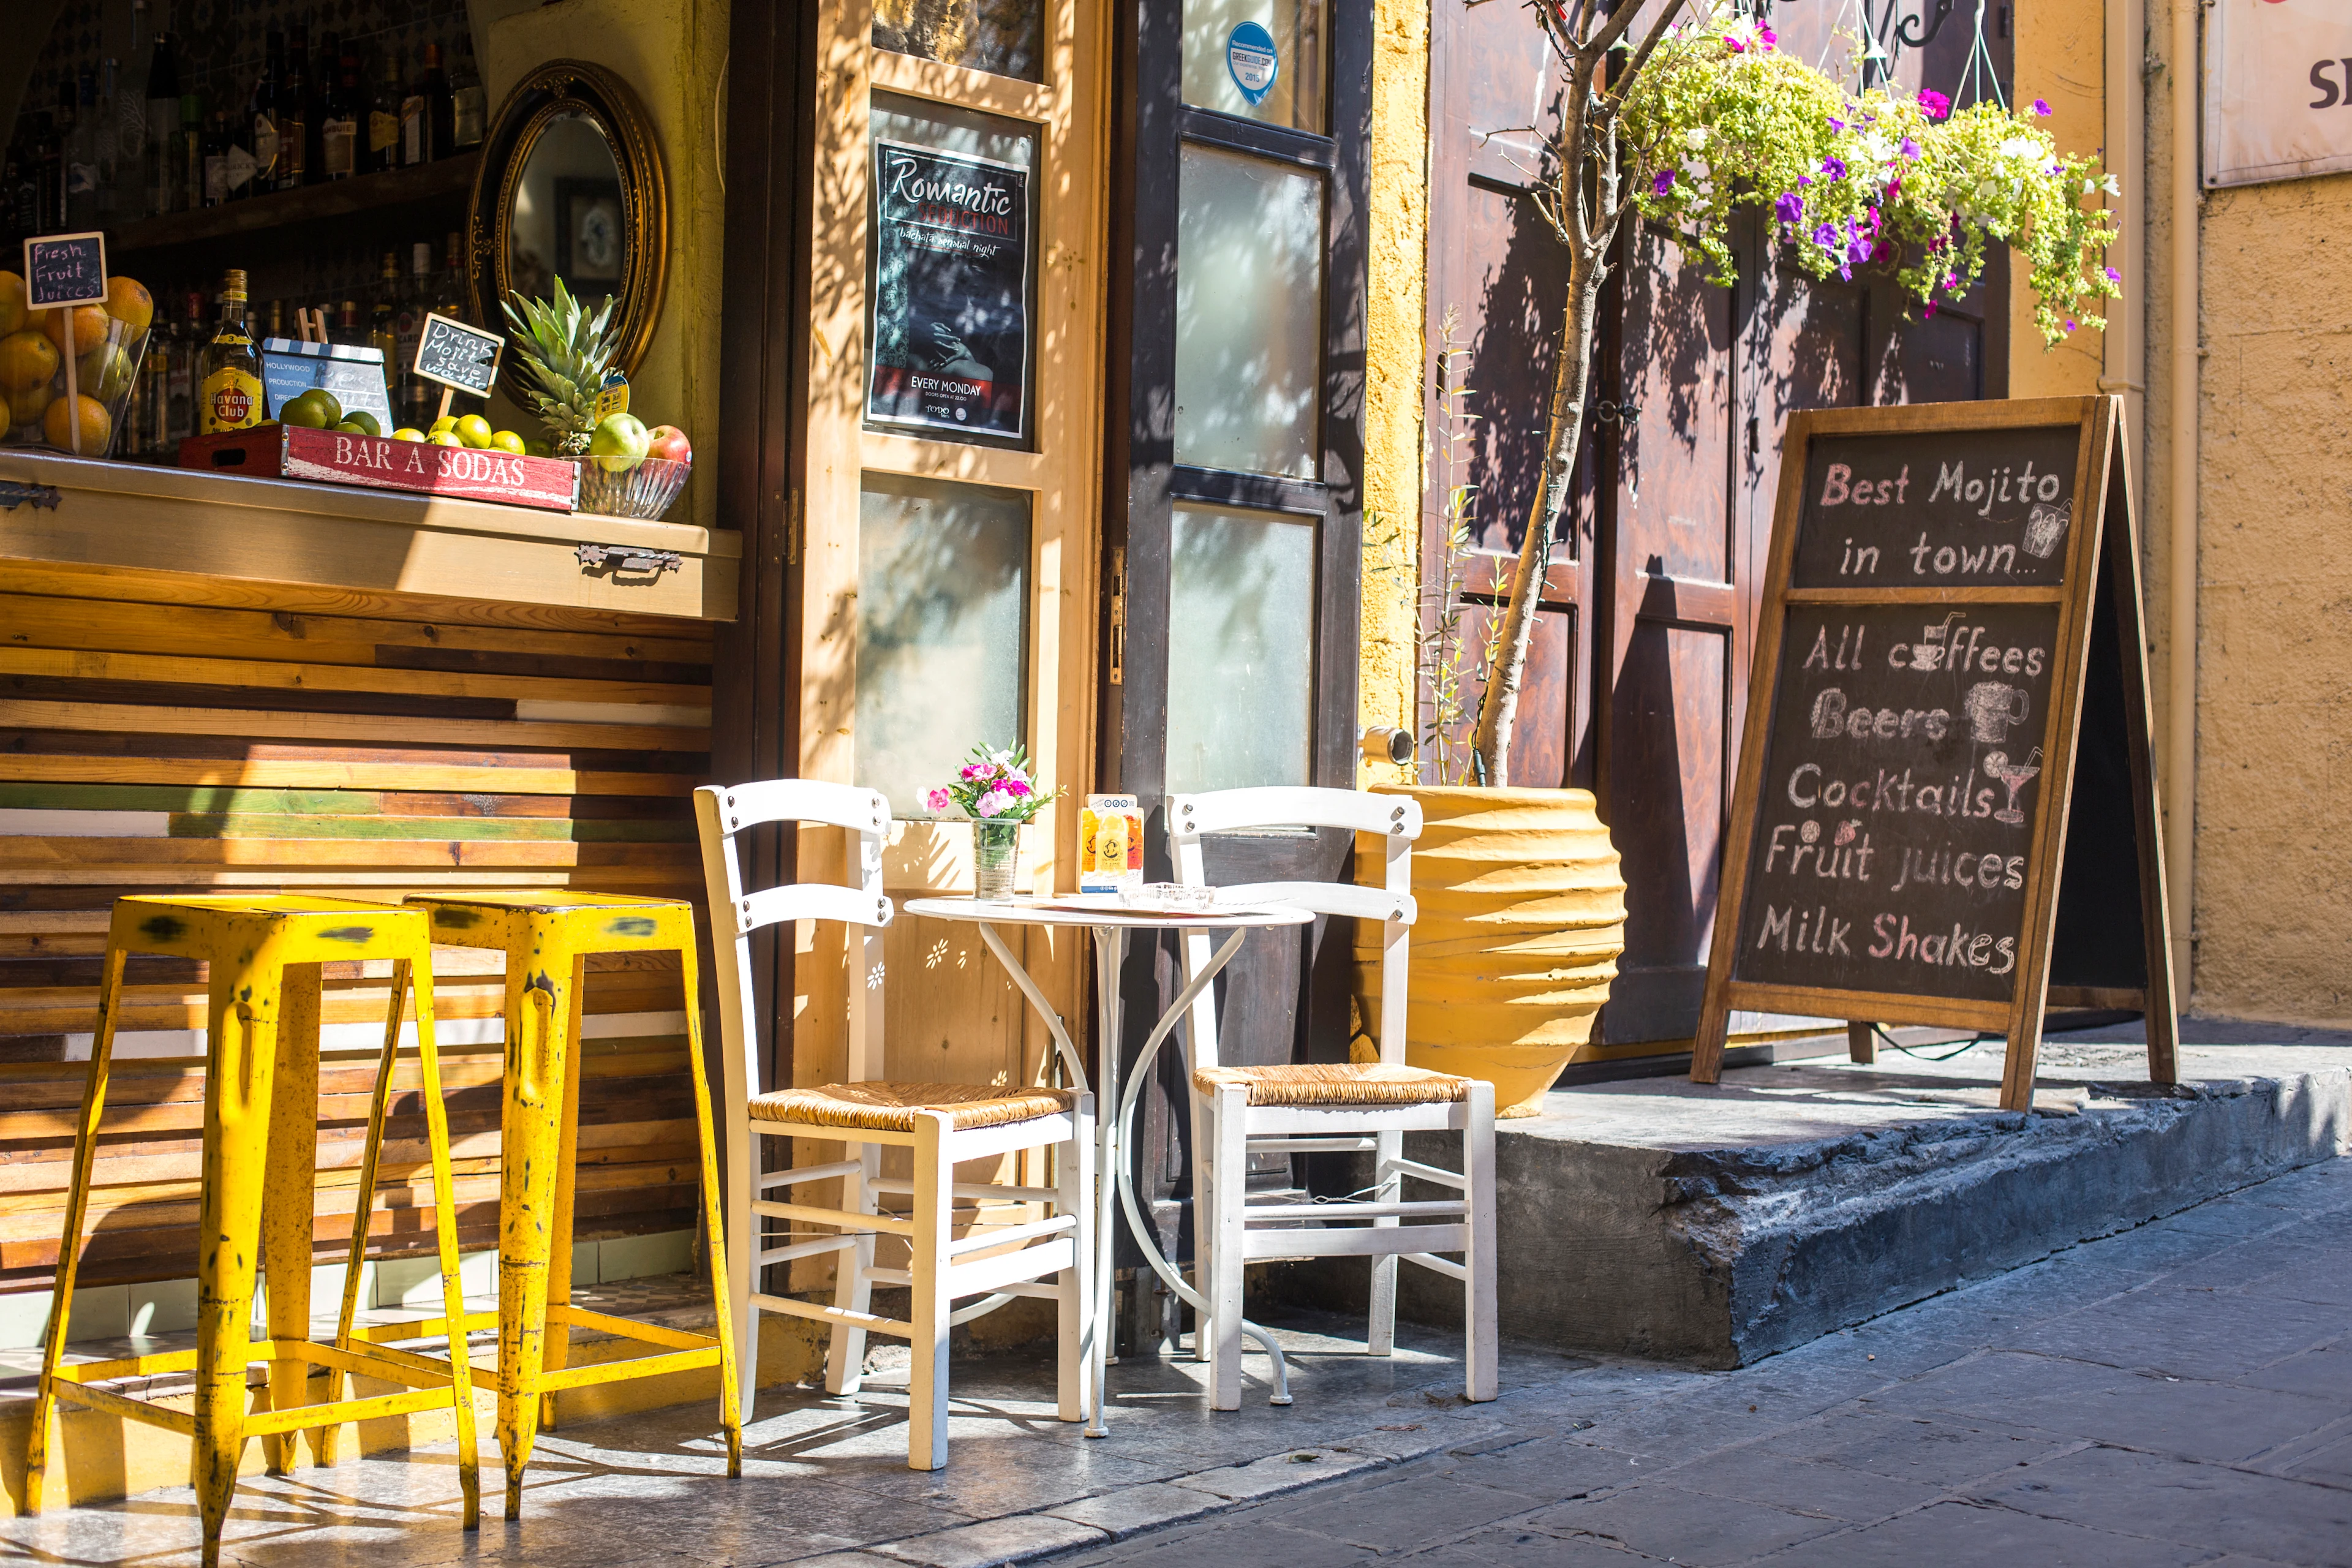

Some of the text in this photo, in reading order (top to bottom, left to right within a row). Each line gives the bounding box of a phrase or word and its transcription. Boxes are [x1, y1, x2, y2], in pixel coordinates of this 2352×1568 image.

[1232, 40, 1266, 52] Recommended
[1245, 72, 1260, 82] 2015
[891, 158, 1011, 216] Romantic
[918, 202, 1008, 235] SEDUCTION
[34, 243, 86, 265] Fresh
[938, 238, 970, 250] sensual
[973, 244, 1001, 260] night
[35, 262, 83, 283] Fruit
[424, 339, 488, 367] Mojito
[432, 323, 494, 357] Drink
[266, 362, 311, 372] HOLLYWOOD
[268, 378, 306, 387] PRODUCTION
[911, 375, 981, 396] EVERY MONDAY
[210, 392, 254, 406] Havana
[218, 405, 244, 417] Club
[334, 435, 525, 486] BAR A SODAS
[1820, 460, 2060, 516] Best Mojito
[1839, 537, 1880, 575] in
[1802, 624, 1866, 670] All
[1810, 687, 1951, 739] Beers
[1787, 763, 1996, 818] Cocktails
[1764, 821, 1875, 881] Fruit
[1756, 903, 2015, 975] Milk Shakes
